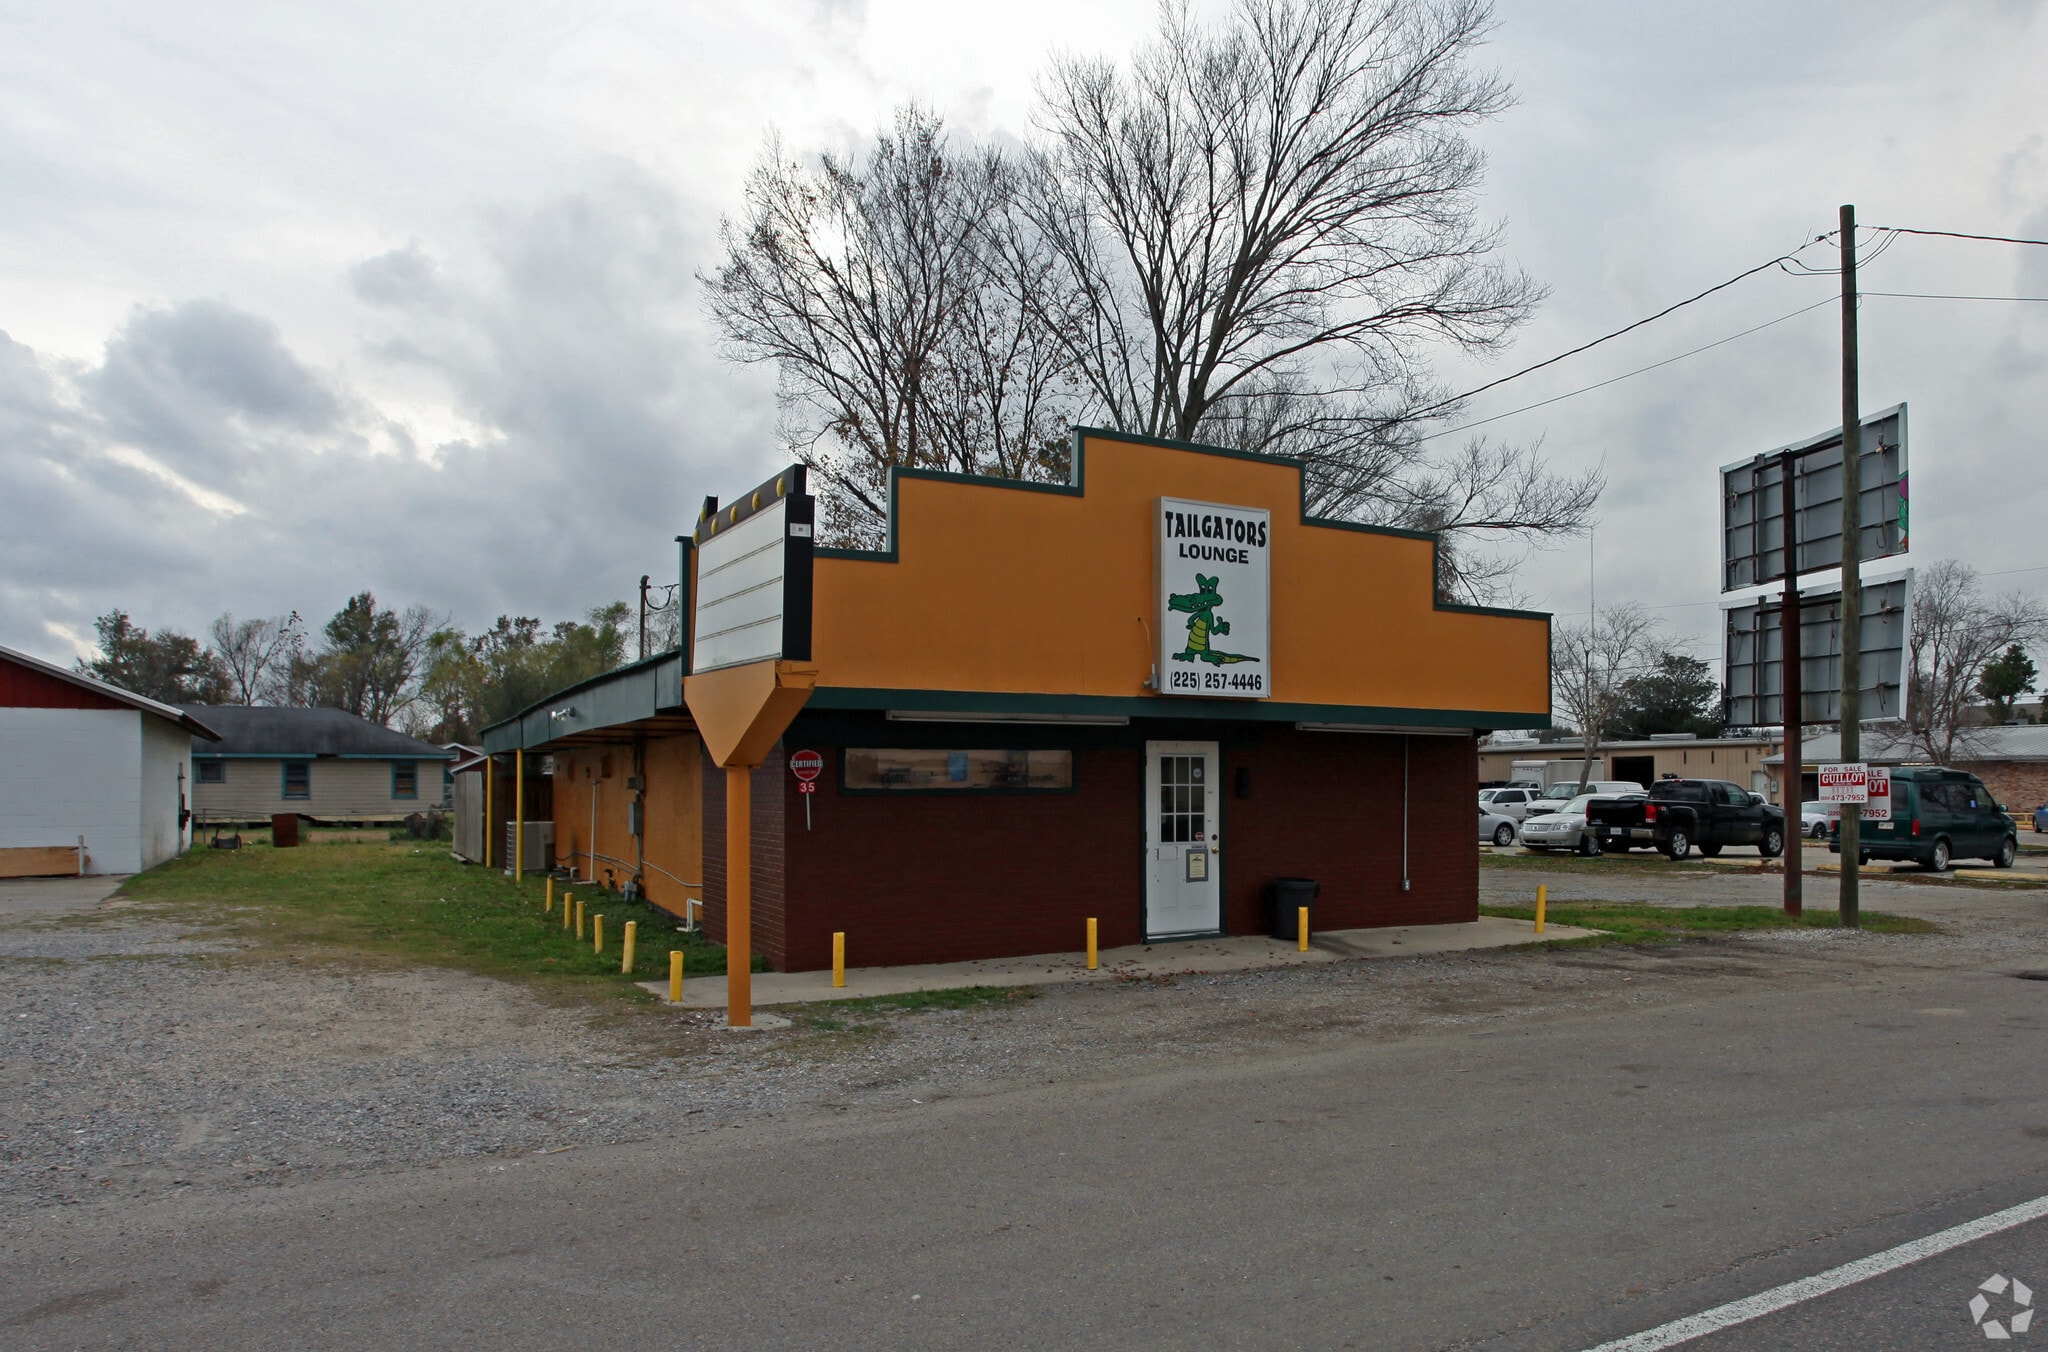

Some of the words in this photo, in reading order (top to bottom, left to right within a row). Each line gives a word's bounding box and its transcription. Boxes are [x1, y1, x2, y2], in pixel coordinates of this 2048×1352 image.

[1165, 511, 1267, 548] TAILGATORS
[1179, 542, 1249, 564] LOUNGE
[1169, 671, 1200, 691] (225)
[1204, 672, 1262, 691] 257-4446
[791, 760, 822, 768] CERTIFIED
[1822, 772, 1864, 784] GUILLOT
[800, 782, 815, 793] 35
[1860, 809, 1887, 818] -7952
